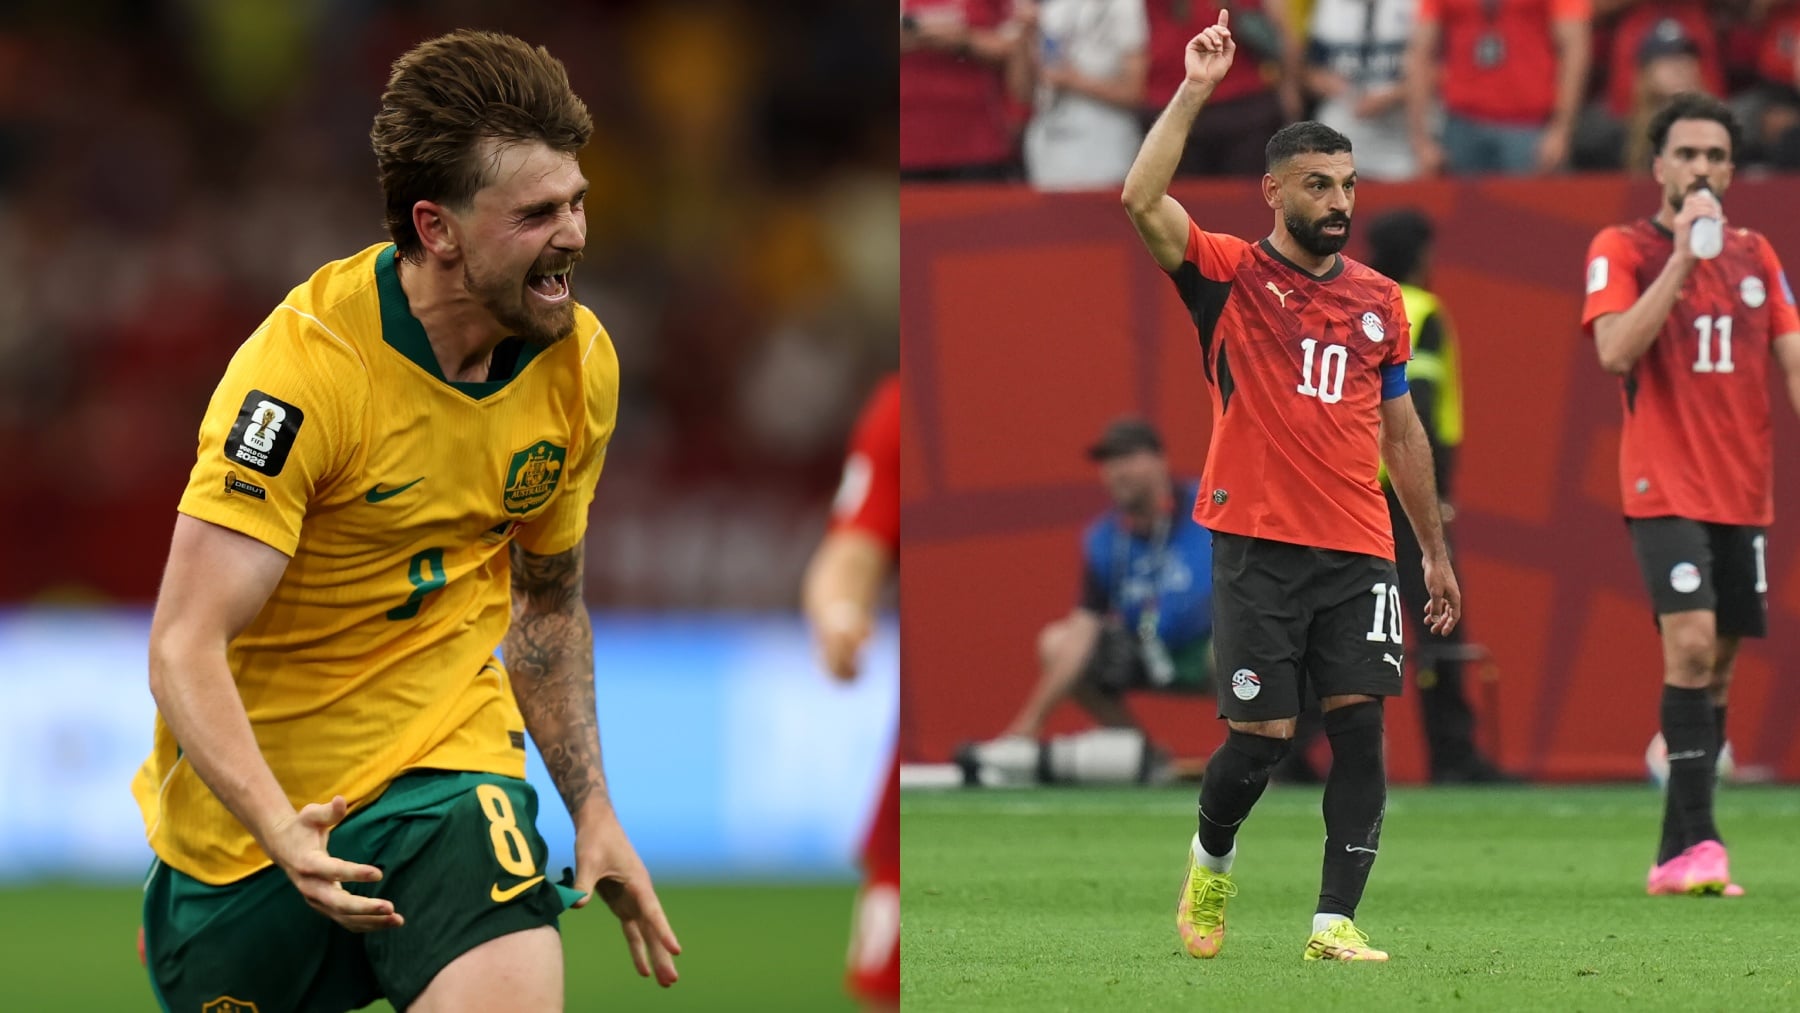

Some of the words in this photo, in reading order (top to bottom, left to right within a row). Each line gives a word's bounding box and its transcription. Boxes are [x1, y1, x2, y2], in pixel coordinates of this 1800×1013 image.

[1692, 315, 1734, 373] 11
[1297, 338, 1348, 404] 10
[250, 437, 264, 447] FIFA
[236, 449, 265, 467] 2026
[240, 444, 257, 456] WORLD
[256, 452, 268, 460] CUP
[235, 481, 264, 494] DEBUT
[511, 483, 549, 499] AUSTRALIA
[1366, 583, 1403, 644] 10
[476, 784, 536, 877] 8
